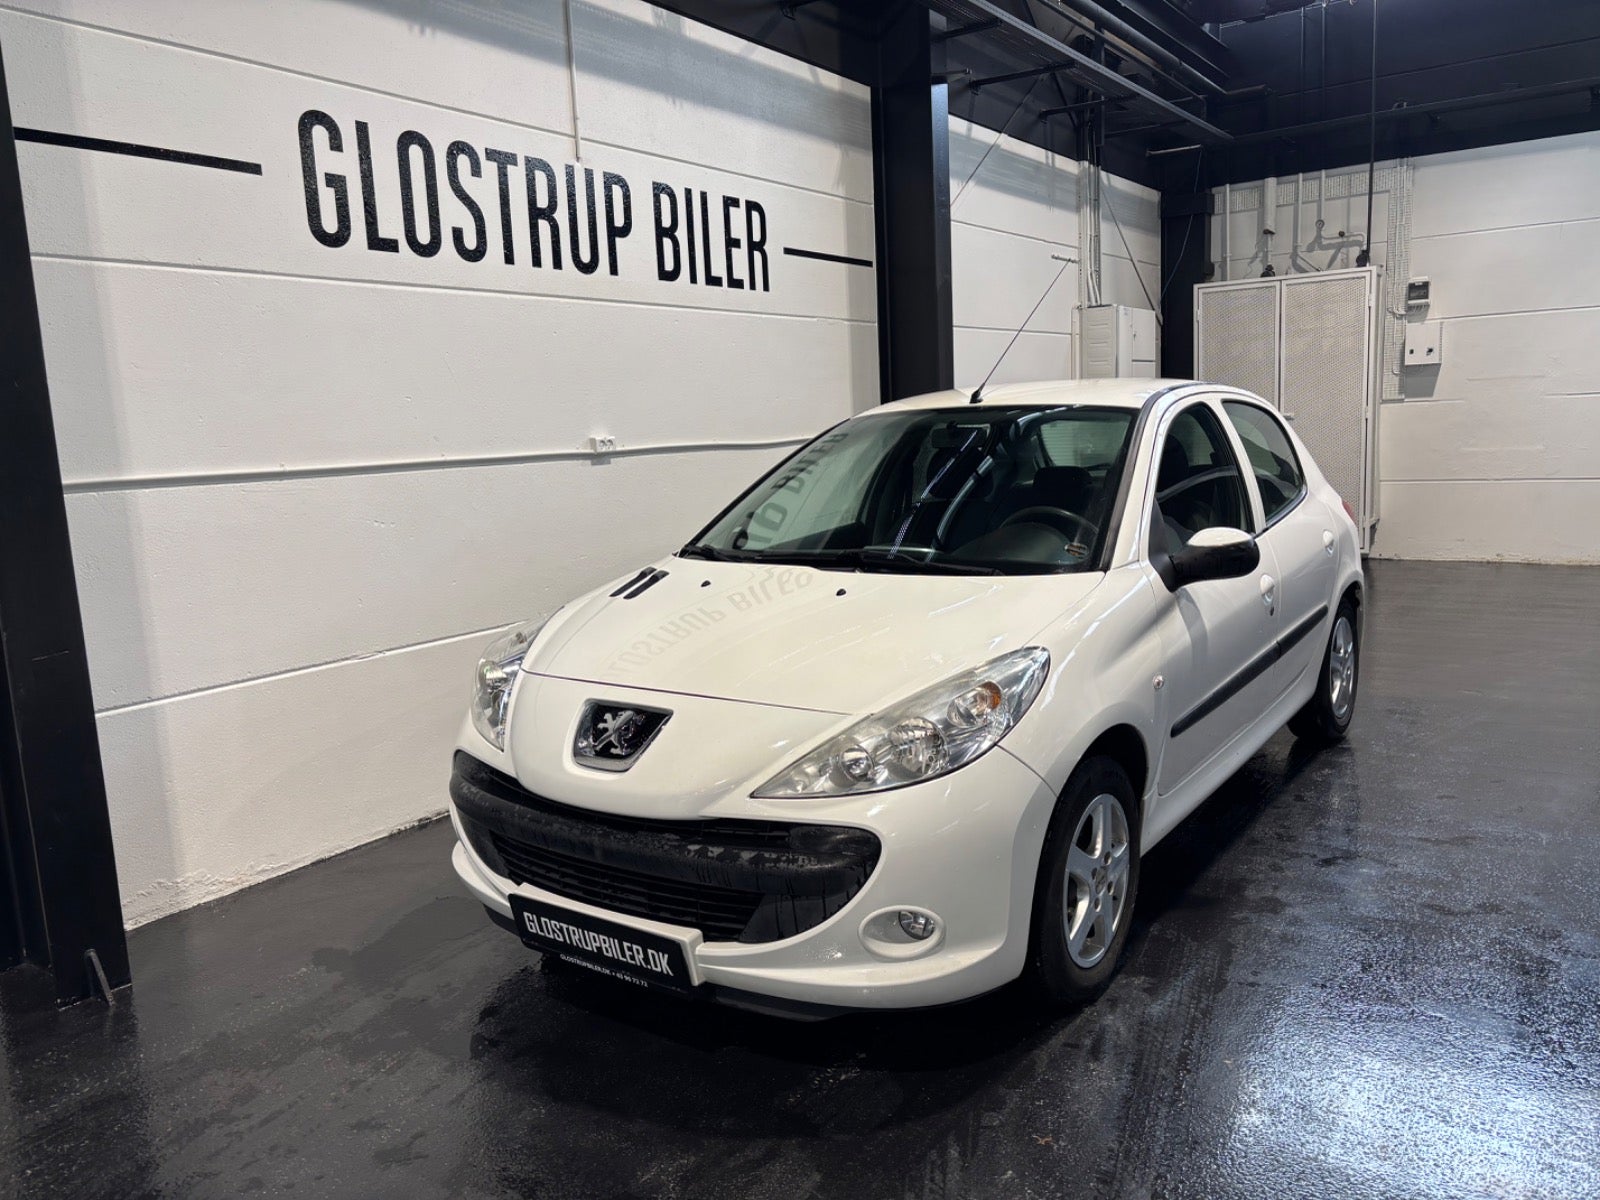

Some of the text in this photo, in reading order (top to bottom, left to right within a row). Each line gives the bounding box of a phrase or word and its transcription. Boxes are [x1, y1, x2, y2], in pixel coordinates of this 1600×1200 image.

[297, 109, 770, 292] GLOSTRUP BILER
[523, 911, 674, 976] GLOSTRUPBILER.DK
